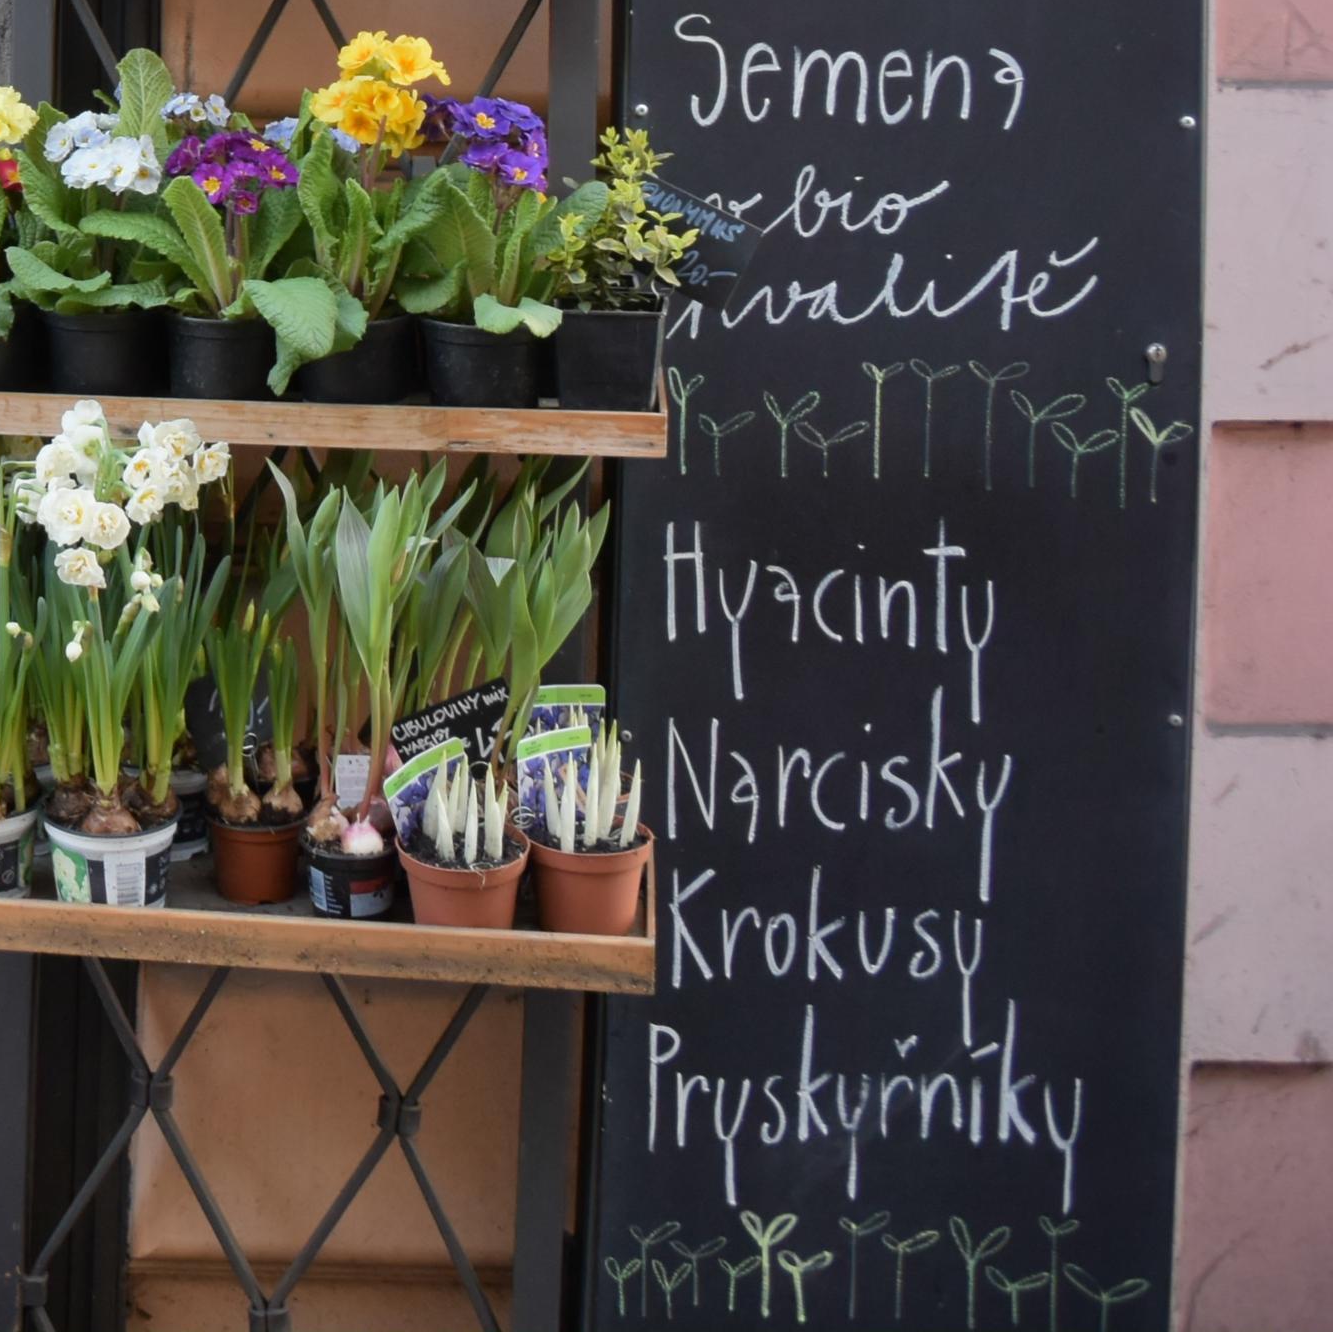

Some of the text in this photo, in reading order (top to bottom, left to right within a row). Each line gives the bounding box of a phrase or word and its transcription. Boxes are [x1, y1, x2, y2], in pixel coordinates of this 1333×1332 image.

[673, 13, 1026, 131] Semena
[763, 165, 950, 238] bio
[663, 516, 995, 723] Hyacinty
[667, 685, 1013, 903] Narcisky
[668, 864, 983, 1047] Krokusy
[647, 999, 1083, 1214] Pryskyřníky
